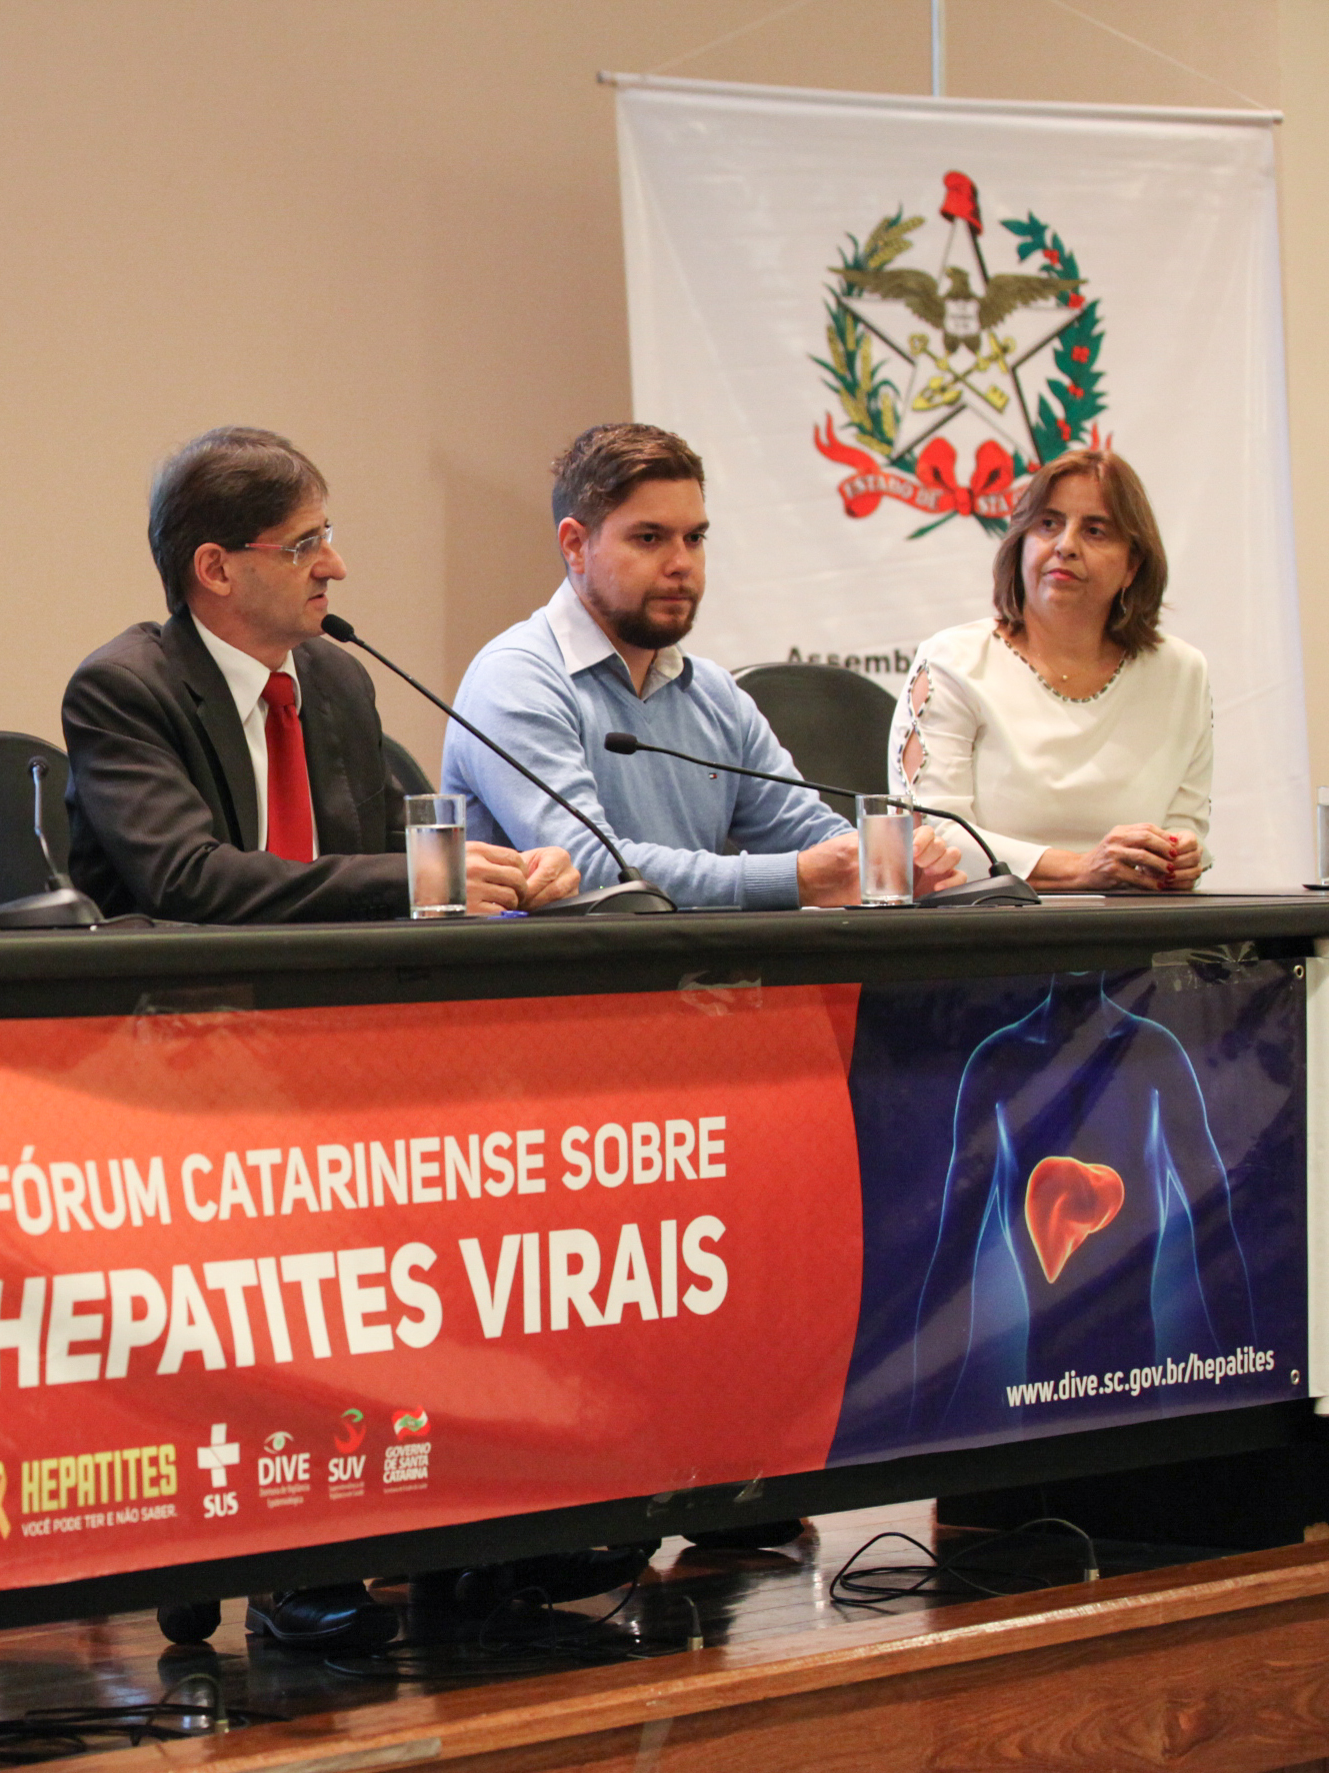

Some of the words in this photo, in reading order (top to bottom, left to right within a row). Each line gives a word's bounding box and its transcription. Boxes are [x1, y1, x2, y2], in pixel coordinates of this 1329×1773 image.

[844, 475, 914, 499] ESTADO
[788, 646, 920, 674] Assemb
[182, 1129, 545, 1223] CATARINENSE
[561, 1116, 726, 1192] SOBRE
[458, 1215, 728, 1340] VIRAIS
[1006, 1346, 1275, 1408] www.dive.sc.gov.br/hepatites
[384, 1458, 397, 1472] DE
[398, 1455, 429, 1469] SANTA
[385, 1442, 431, 1459] GOVERNO
[21, 1444, 178, 1514] HEPATITES
[258, 1452, 311, 1486] DIVE
[328, 1454, 366, 1482] SUV
[383, 1466, 429, 1484] CATARINA
[53, 1515, 82, 1533] PODE
[85, 1512, 106, 1529] TER
[106, 1510, 115, 1526] E
[116, 1505, 140, 1525] NÃO
[203, 1491, 239, 1519] SUS
